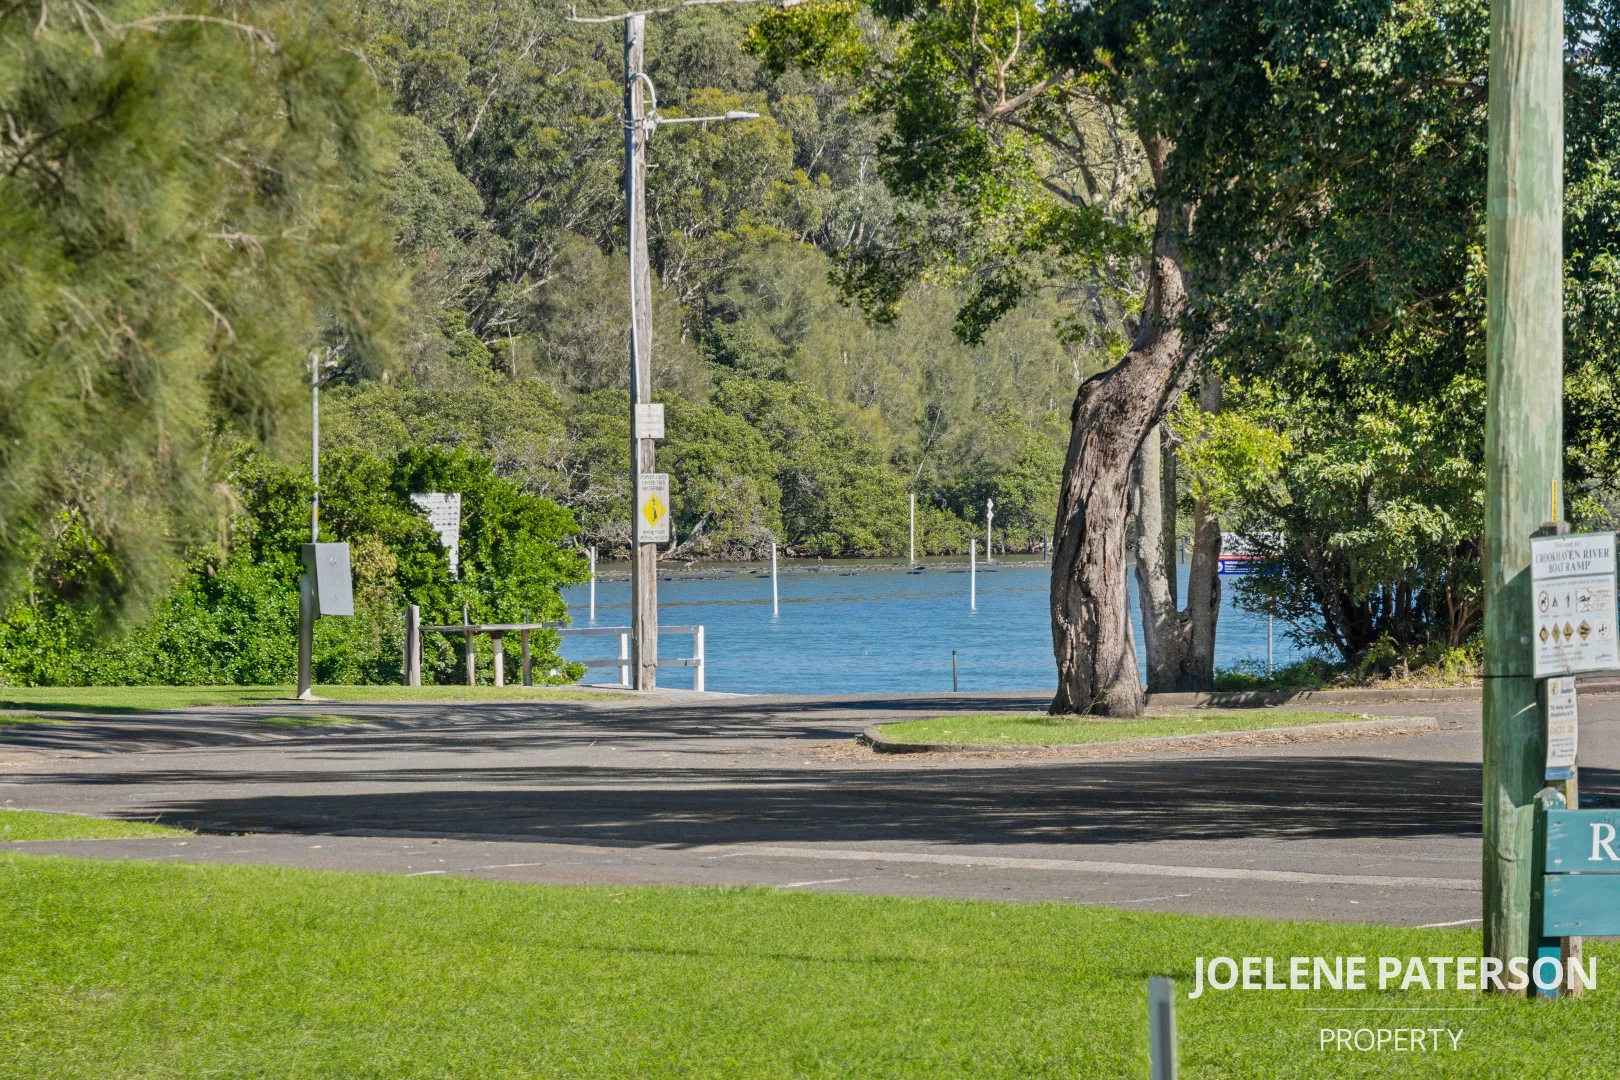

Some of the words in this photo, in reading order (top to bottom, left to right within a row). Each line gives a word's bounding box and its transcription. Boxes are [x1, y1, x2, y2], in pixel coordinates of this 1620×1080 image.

[1535, 549, 1581, 563] CROOKHAVEN
[1583, 548, 1610, 559] RIVER
[1548, 562, 1564, 574] BOAT
[1565, 561, 1591, 573] RAMP
[1588, 823, 1620, 861] R
